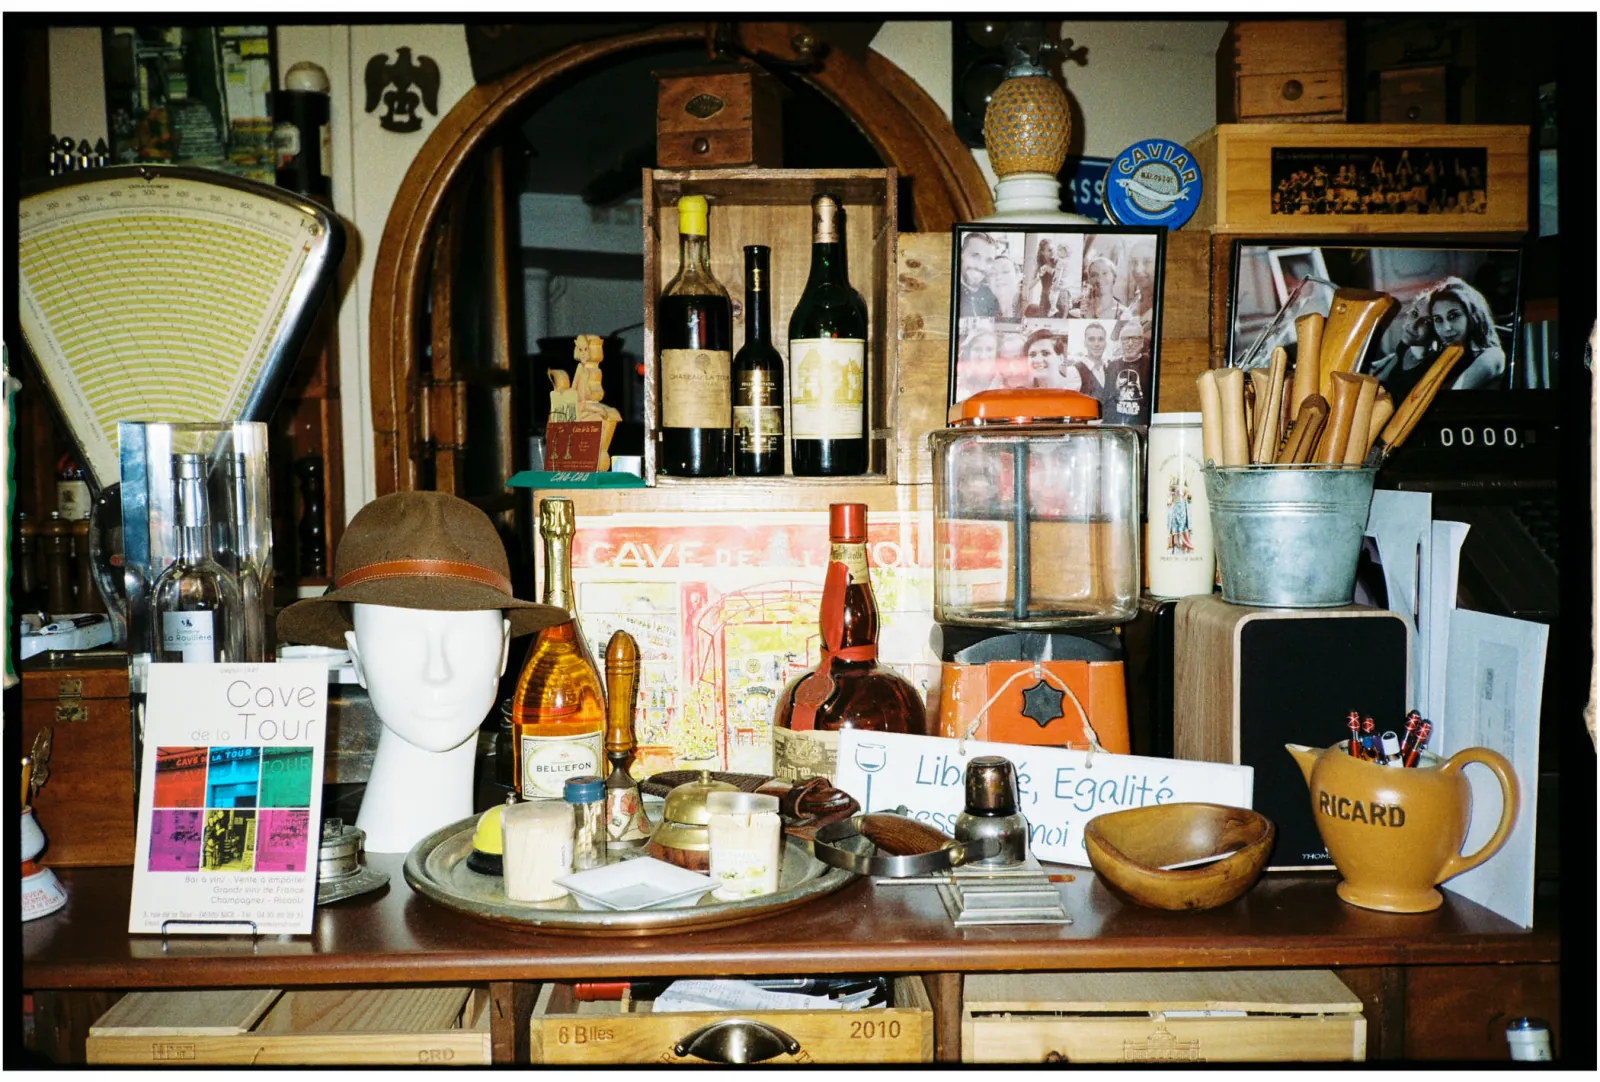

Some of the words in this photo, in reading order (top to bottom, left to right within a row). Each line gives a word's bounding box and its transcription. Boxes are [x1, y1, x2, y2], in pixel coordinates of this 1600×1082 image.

[1118, 143, 1197, 185] CAVIAR
[587, 540, 704, 568] CAVE
[226, 679, 316, 708] Cave
[191, 729, 210, 741] de
[216, 728, 231, 741] la
[237, 713, 316, 741] Tour
[225, 748, 252, 759] TOUR
[536, 761, 592, 773] BELLEFON
[1319, 789, 1406, 829] RICARD
[185, 875, 199, 884] Bar
[234, 875, 258, 884] Vente
[276, 886, 305, 895] France
[558, 1025, 570, 1045] 6
[850, 1020, 902, 1039] 2010
